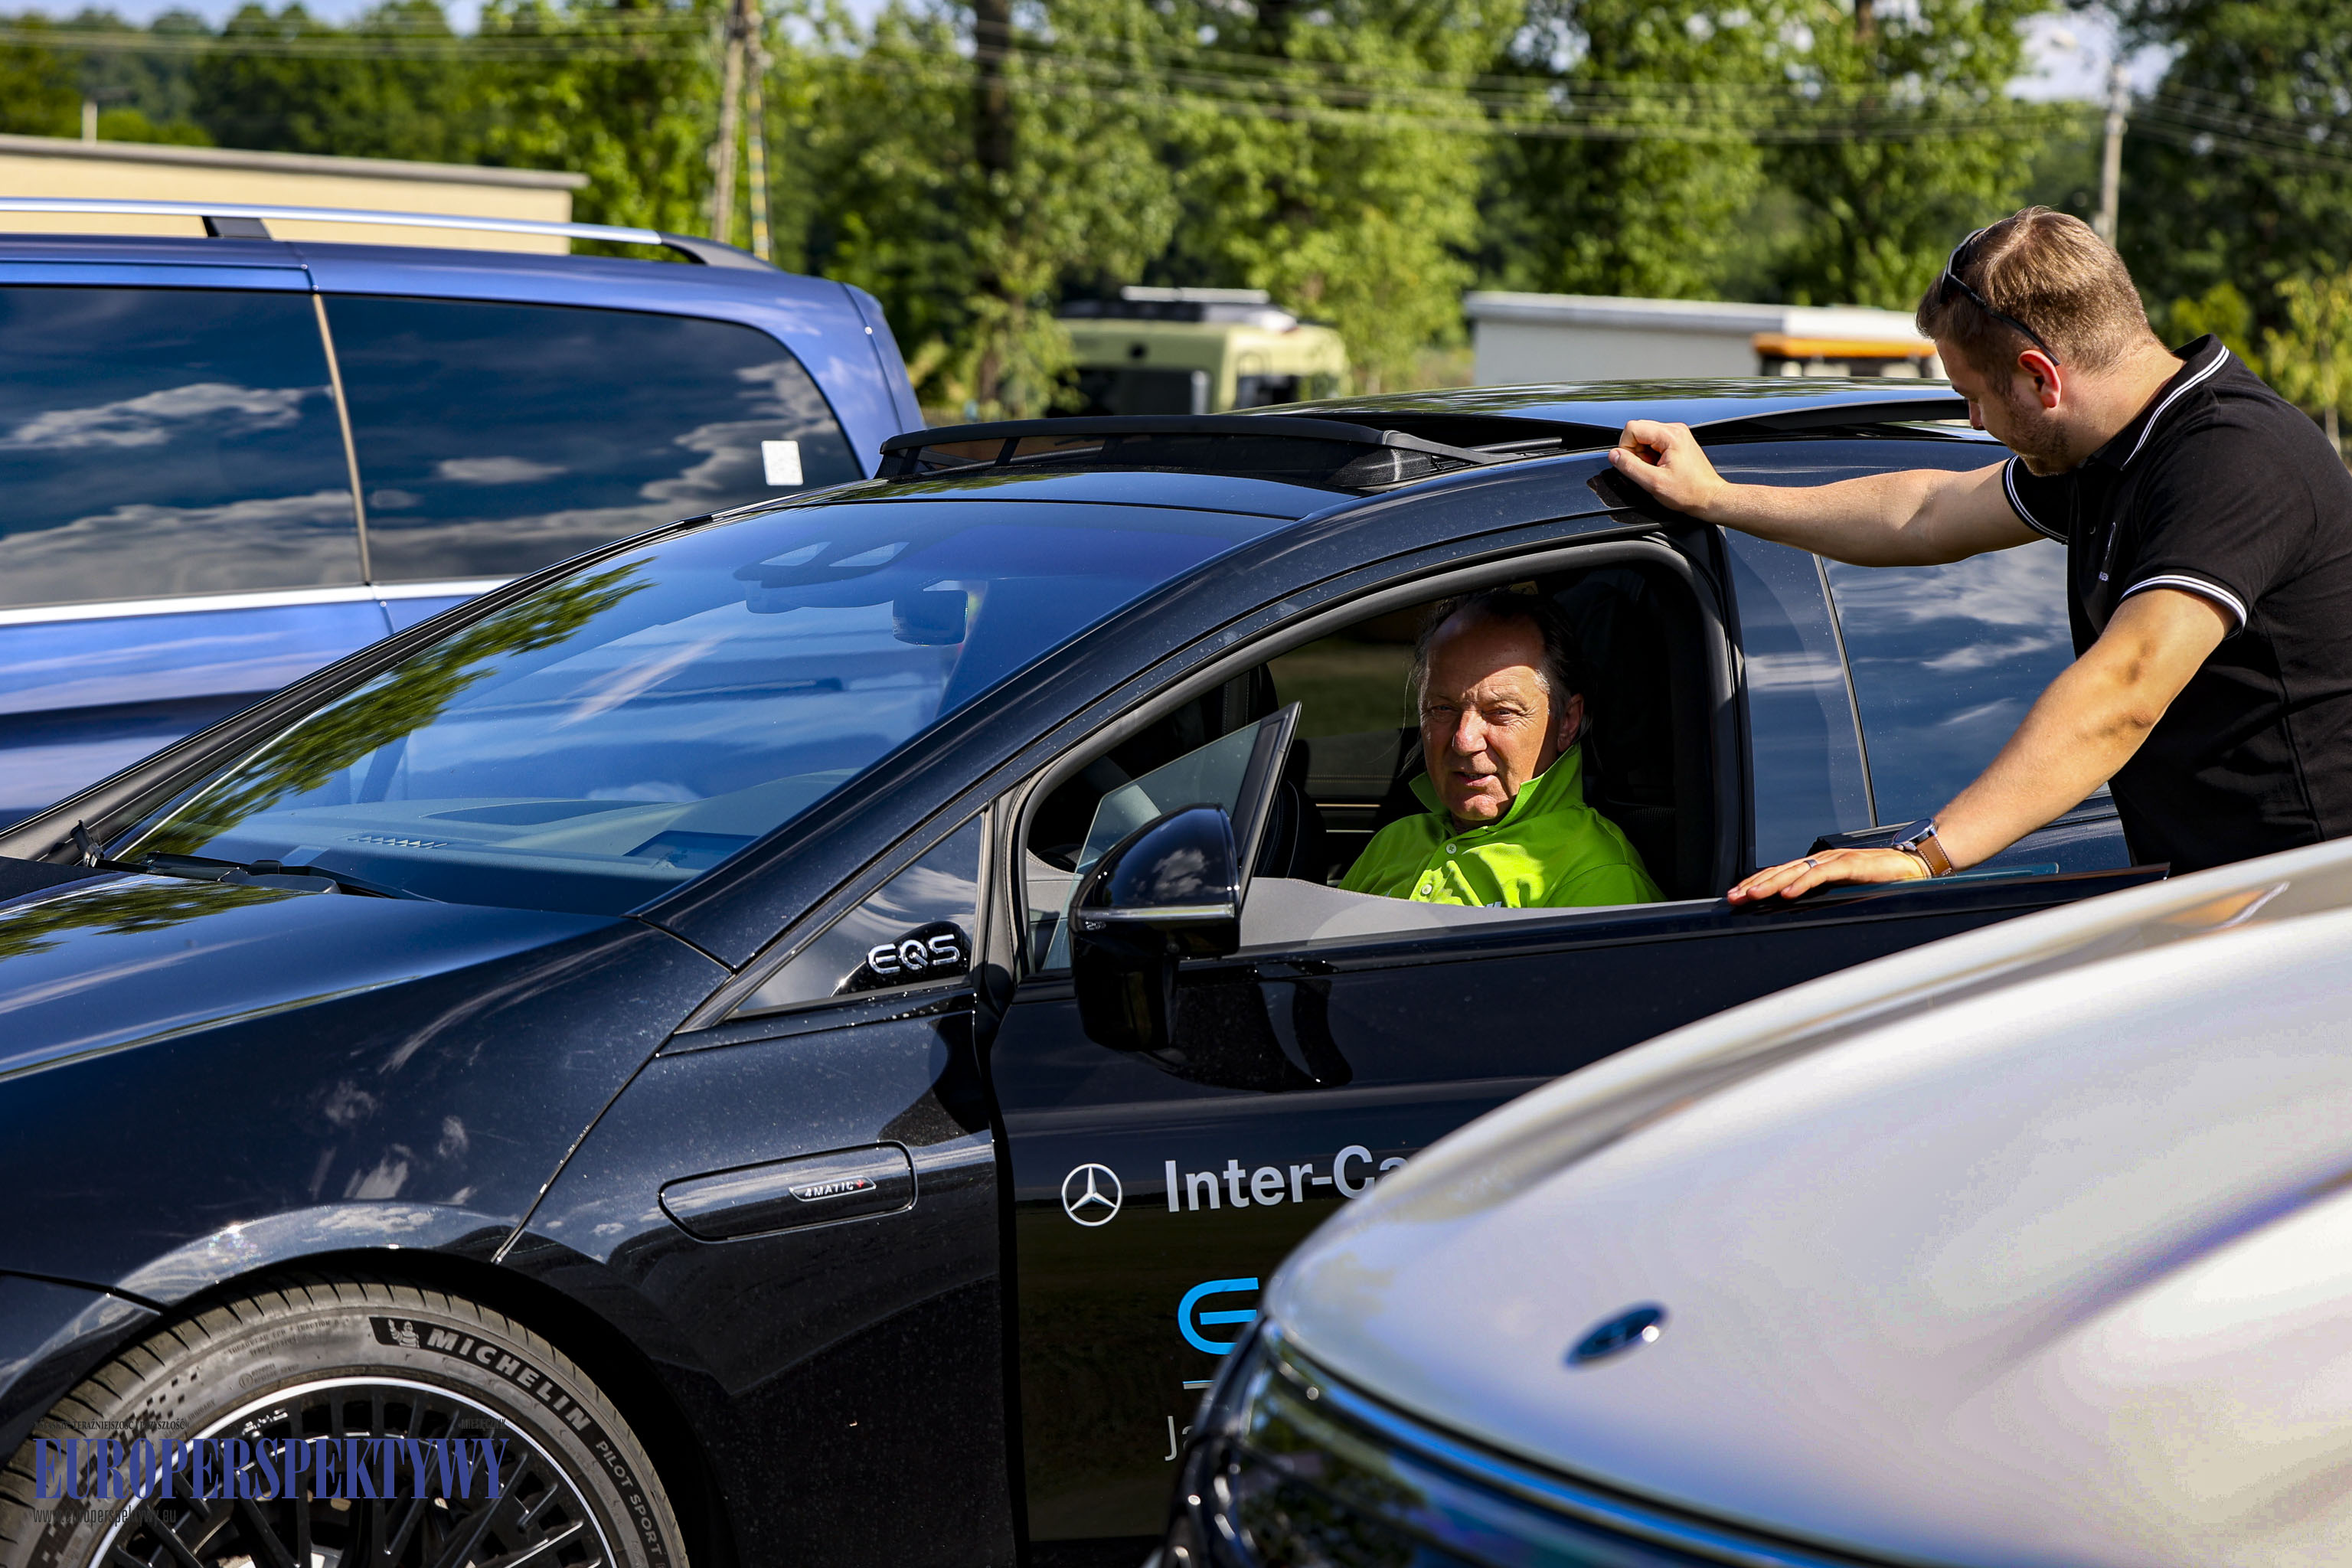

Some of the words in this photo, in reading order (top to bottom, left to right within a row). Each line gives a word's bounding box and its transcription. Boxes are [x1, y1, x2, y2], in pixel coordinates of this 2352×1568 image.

[867, 933, 961, 975] EQS
[426, 1328, 592, 1432] MICHELIN
[596, 1440, 634, 1488] PILOT
[630, 1494, 663, 1555] SPORT
